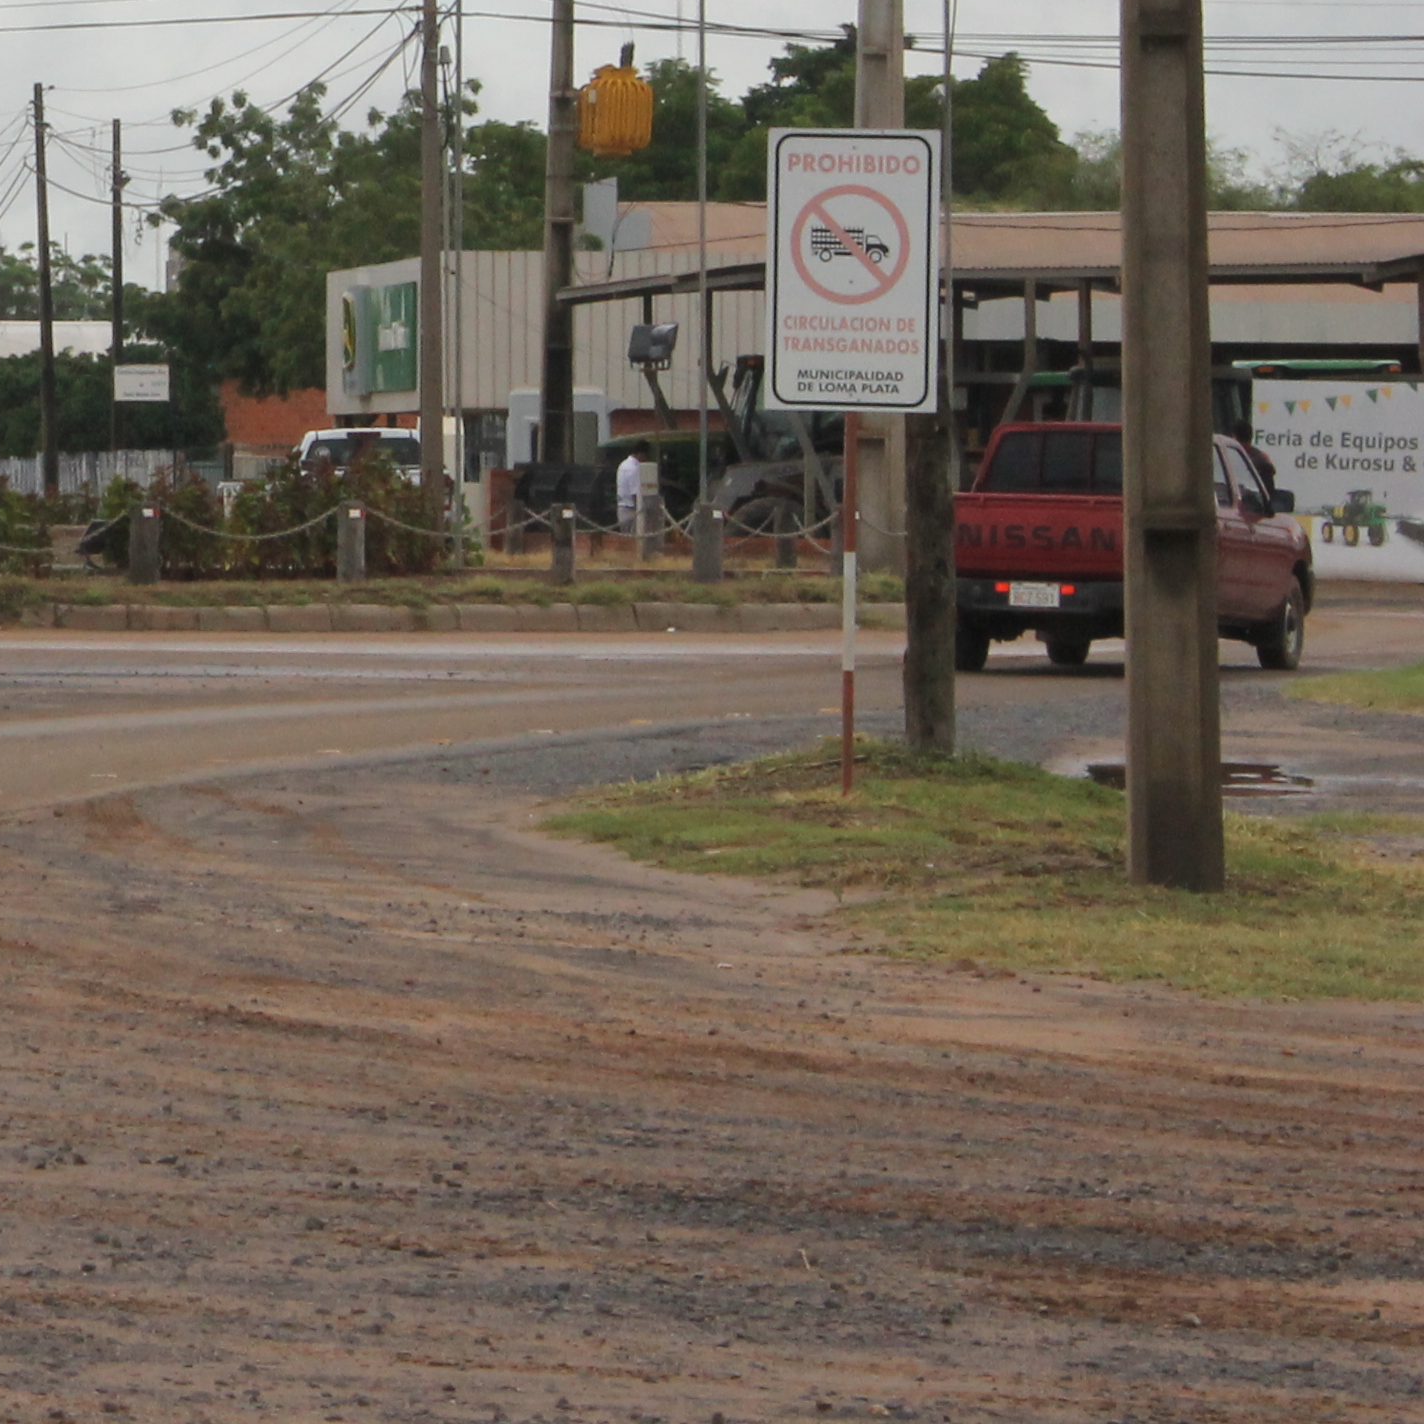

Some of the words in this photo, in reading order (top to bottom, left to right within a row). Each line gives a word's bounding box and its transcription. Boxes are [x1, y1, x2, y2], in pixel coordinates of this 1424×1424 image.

[787, 153, 921, 175] PROHIBIDO
[783, 315, 891, 332] CIRCULACION
[896, 317, 916, 333] DE
[784, 336, 920, 354] TRANSGANADOS
[797, 369, 904, 382] MUNICIPALIDAD
[797, 382, 813, 392] DE
[819, 383, 857, 394] LOMA
[861, 384, 899, 394] PLATA
[1254, 430, 1302, 446] Feria
[1310, 431, 1333, 447] de
[1341, 432, 1419, 453] Equipos
[1295, 454, 1318, 469] de
[1326, 454, 1395, 472] Kurosu
[1402, 456, 1417, 472] &
[958, 523, 1116, 550] NISSAN
